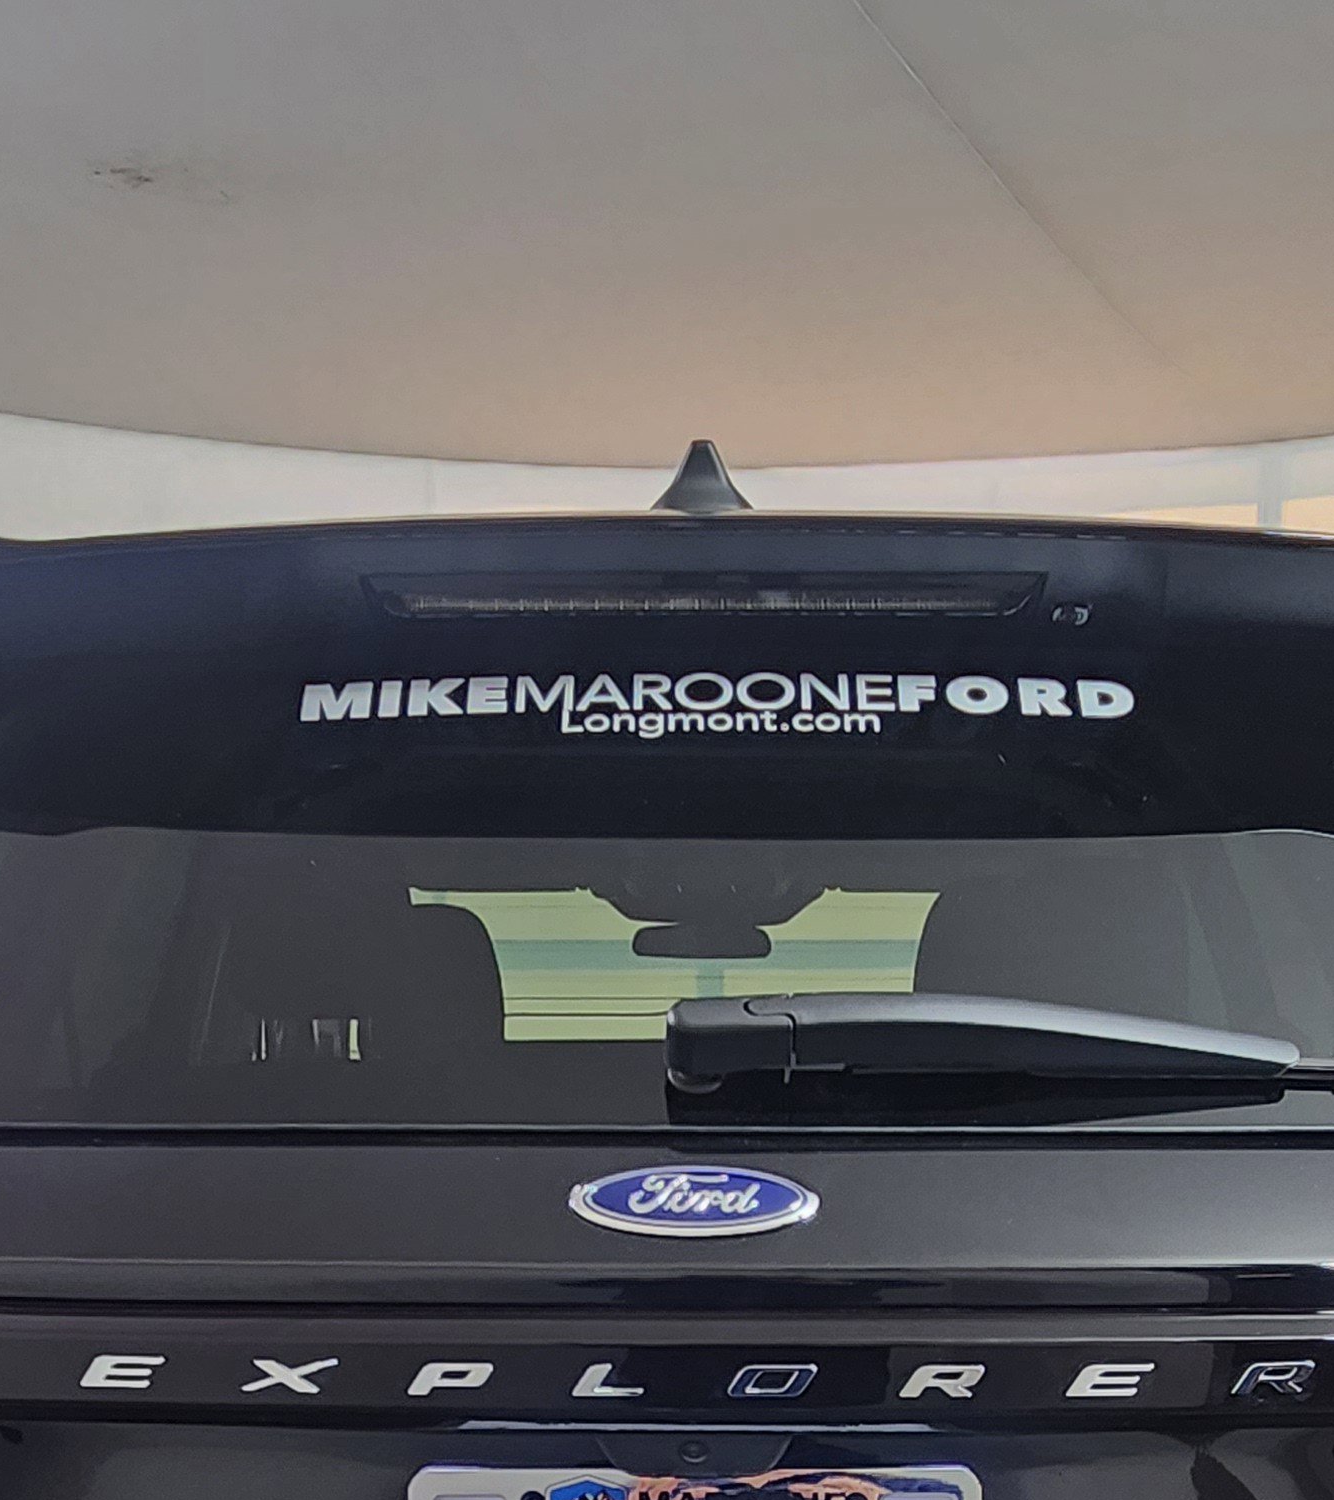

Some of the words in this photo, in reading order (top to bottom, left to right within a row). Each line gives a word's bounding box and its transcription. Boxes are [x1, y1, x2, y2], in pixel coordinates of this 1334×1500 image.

[560, 704, 882, 738] Longmont.com
[627, 1173, 761, 1214] Ford
[78, 1354, 1316, 1400] EXPLORER
